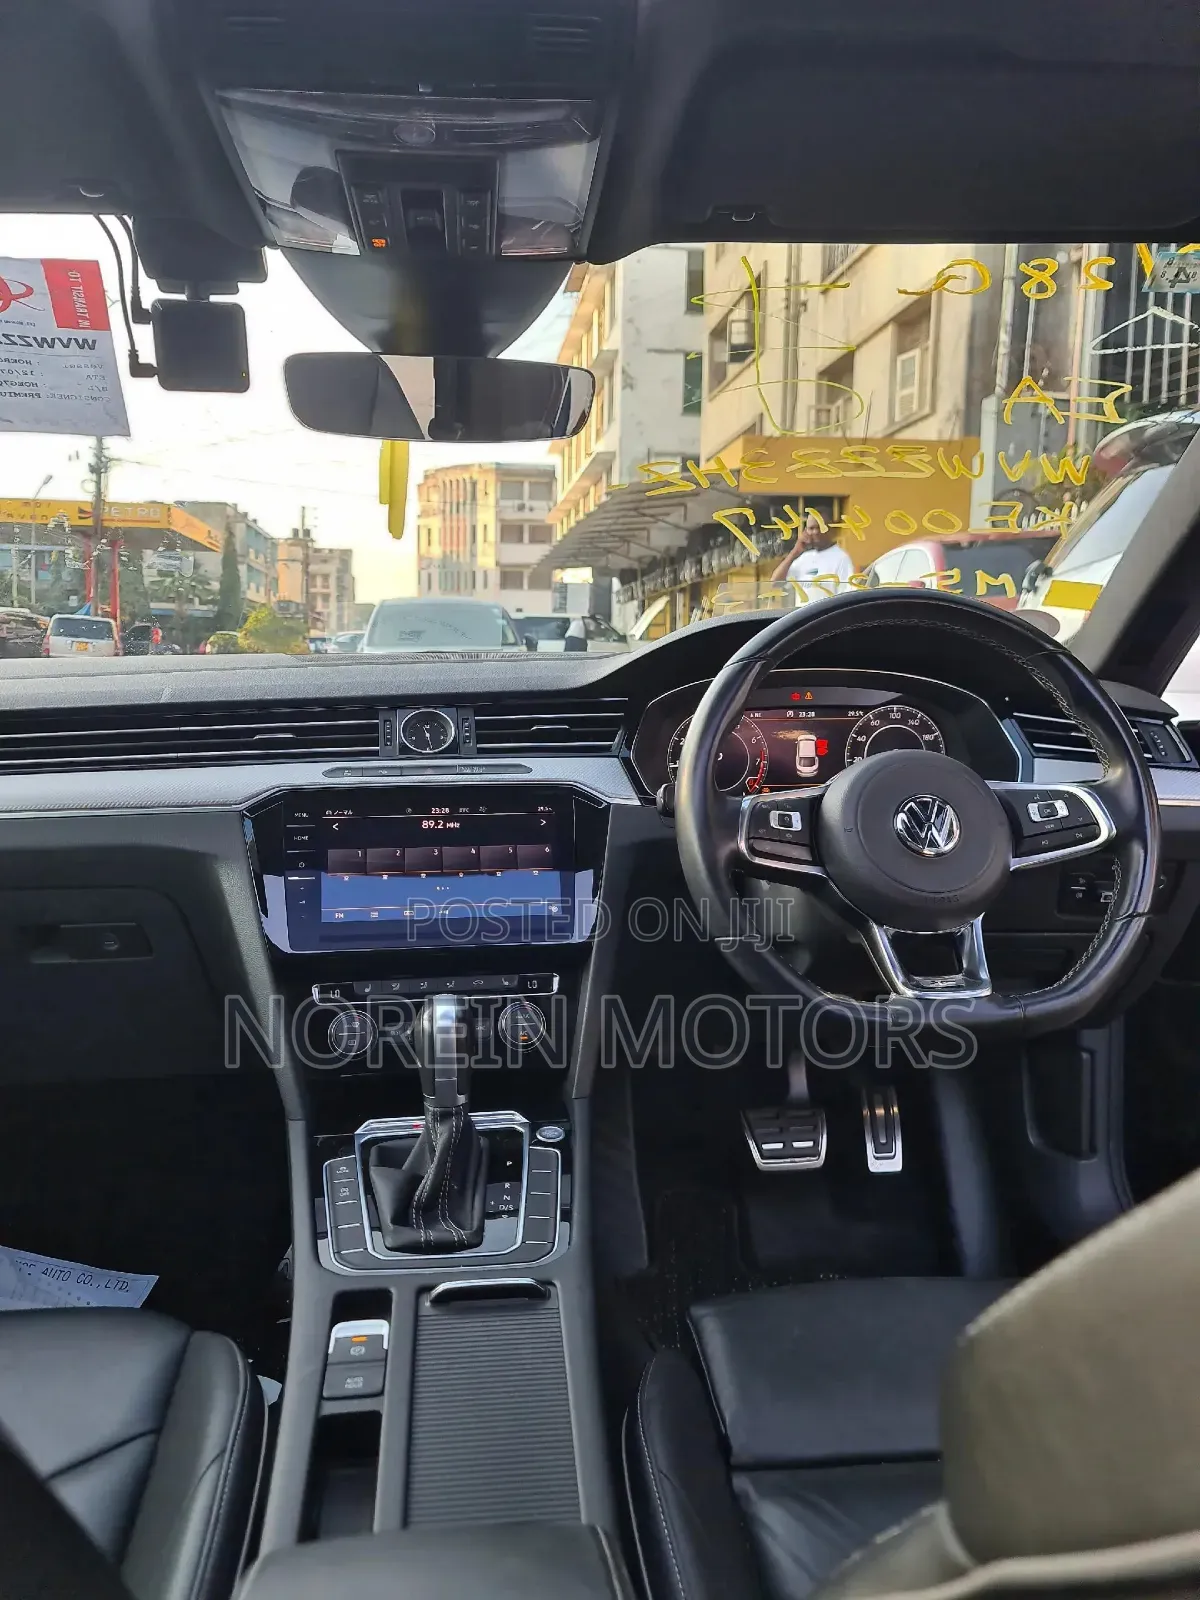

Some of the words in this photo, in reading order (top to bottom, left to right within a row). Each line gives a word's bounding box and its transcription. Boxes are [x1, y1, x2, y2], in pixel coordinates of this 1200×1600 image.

[888, 712, 902, 720] 100
[870, 719, 881, 727] 60
[421, 820, 444, 829] 89.2
[41, 1267, 72, 1282] AUTO
